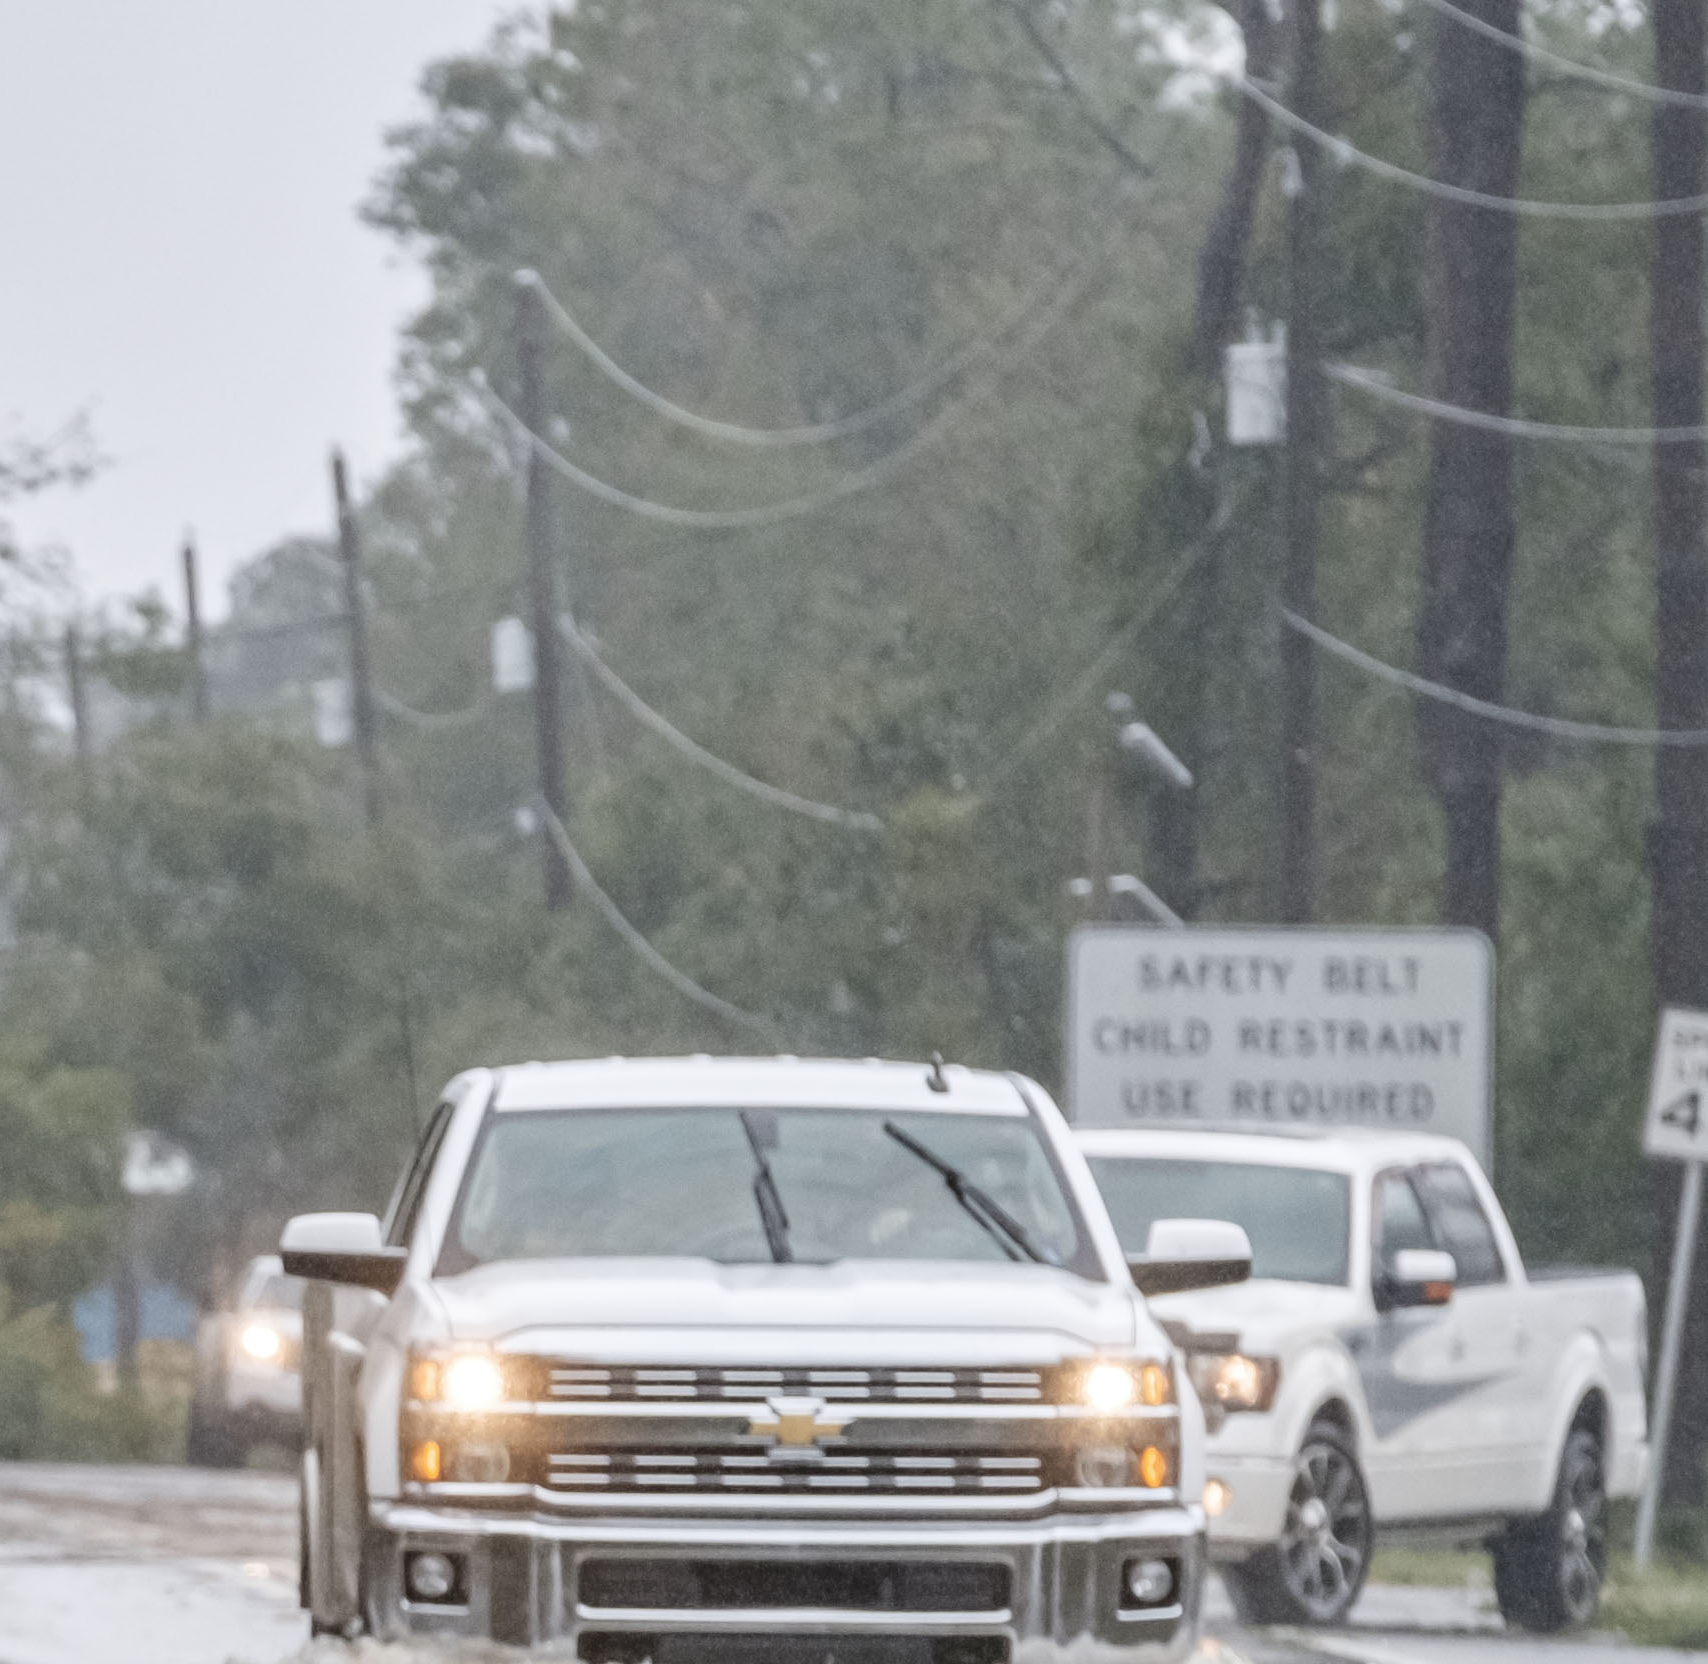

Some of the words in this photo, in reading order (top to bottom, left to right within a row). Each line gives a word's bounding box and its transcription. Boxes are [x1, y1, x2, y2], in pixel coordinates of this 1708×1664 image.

[1136, 953, 1294, 995] SAFETY
[1321, 954, 1422, 995] BELT
[1092, 1016, 1213, 1057] CHILD
[1237, 1016, 1465, 1058] RESTRAINT
[1120, 1078, 1200, 1119] USE
[1229, 1078, 1437, 1122] REQUIRED
